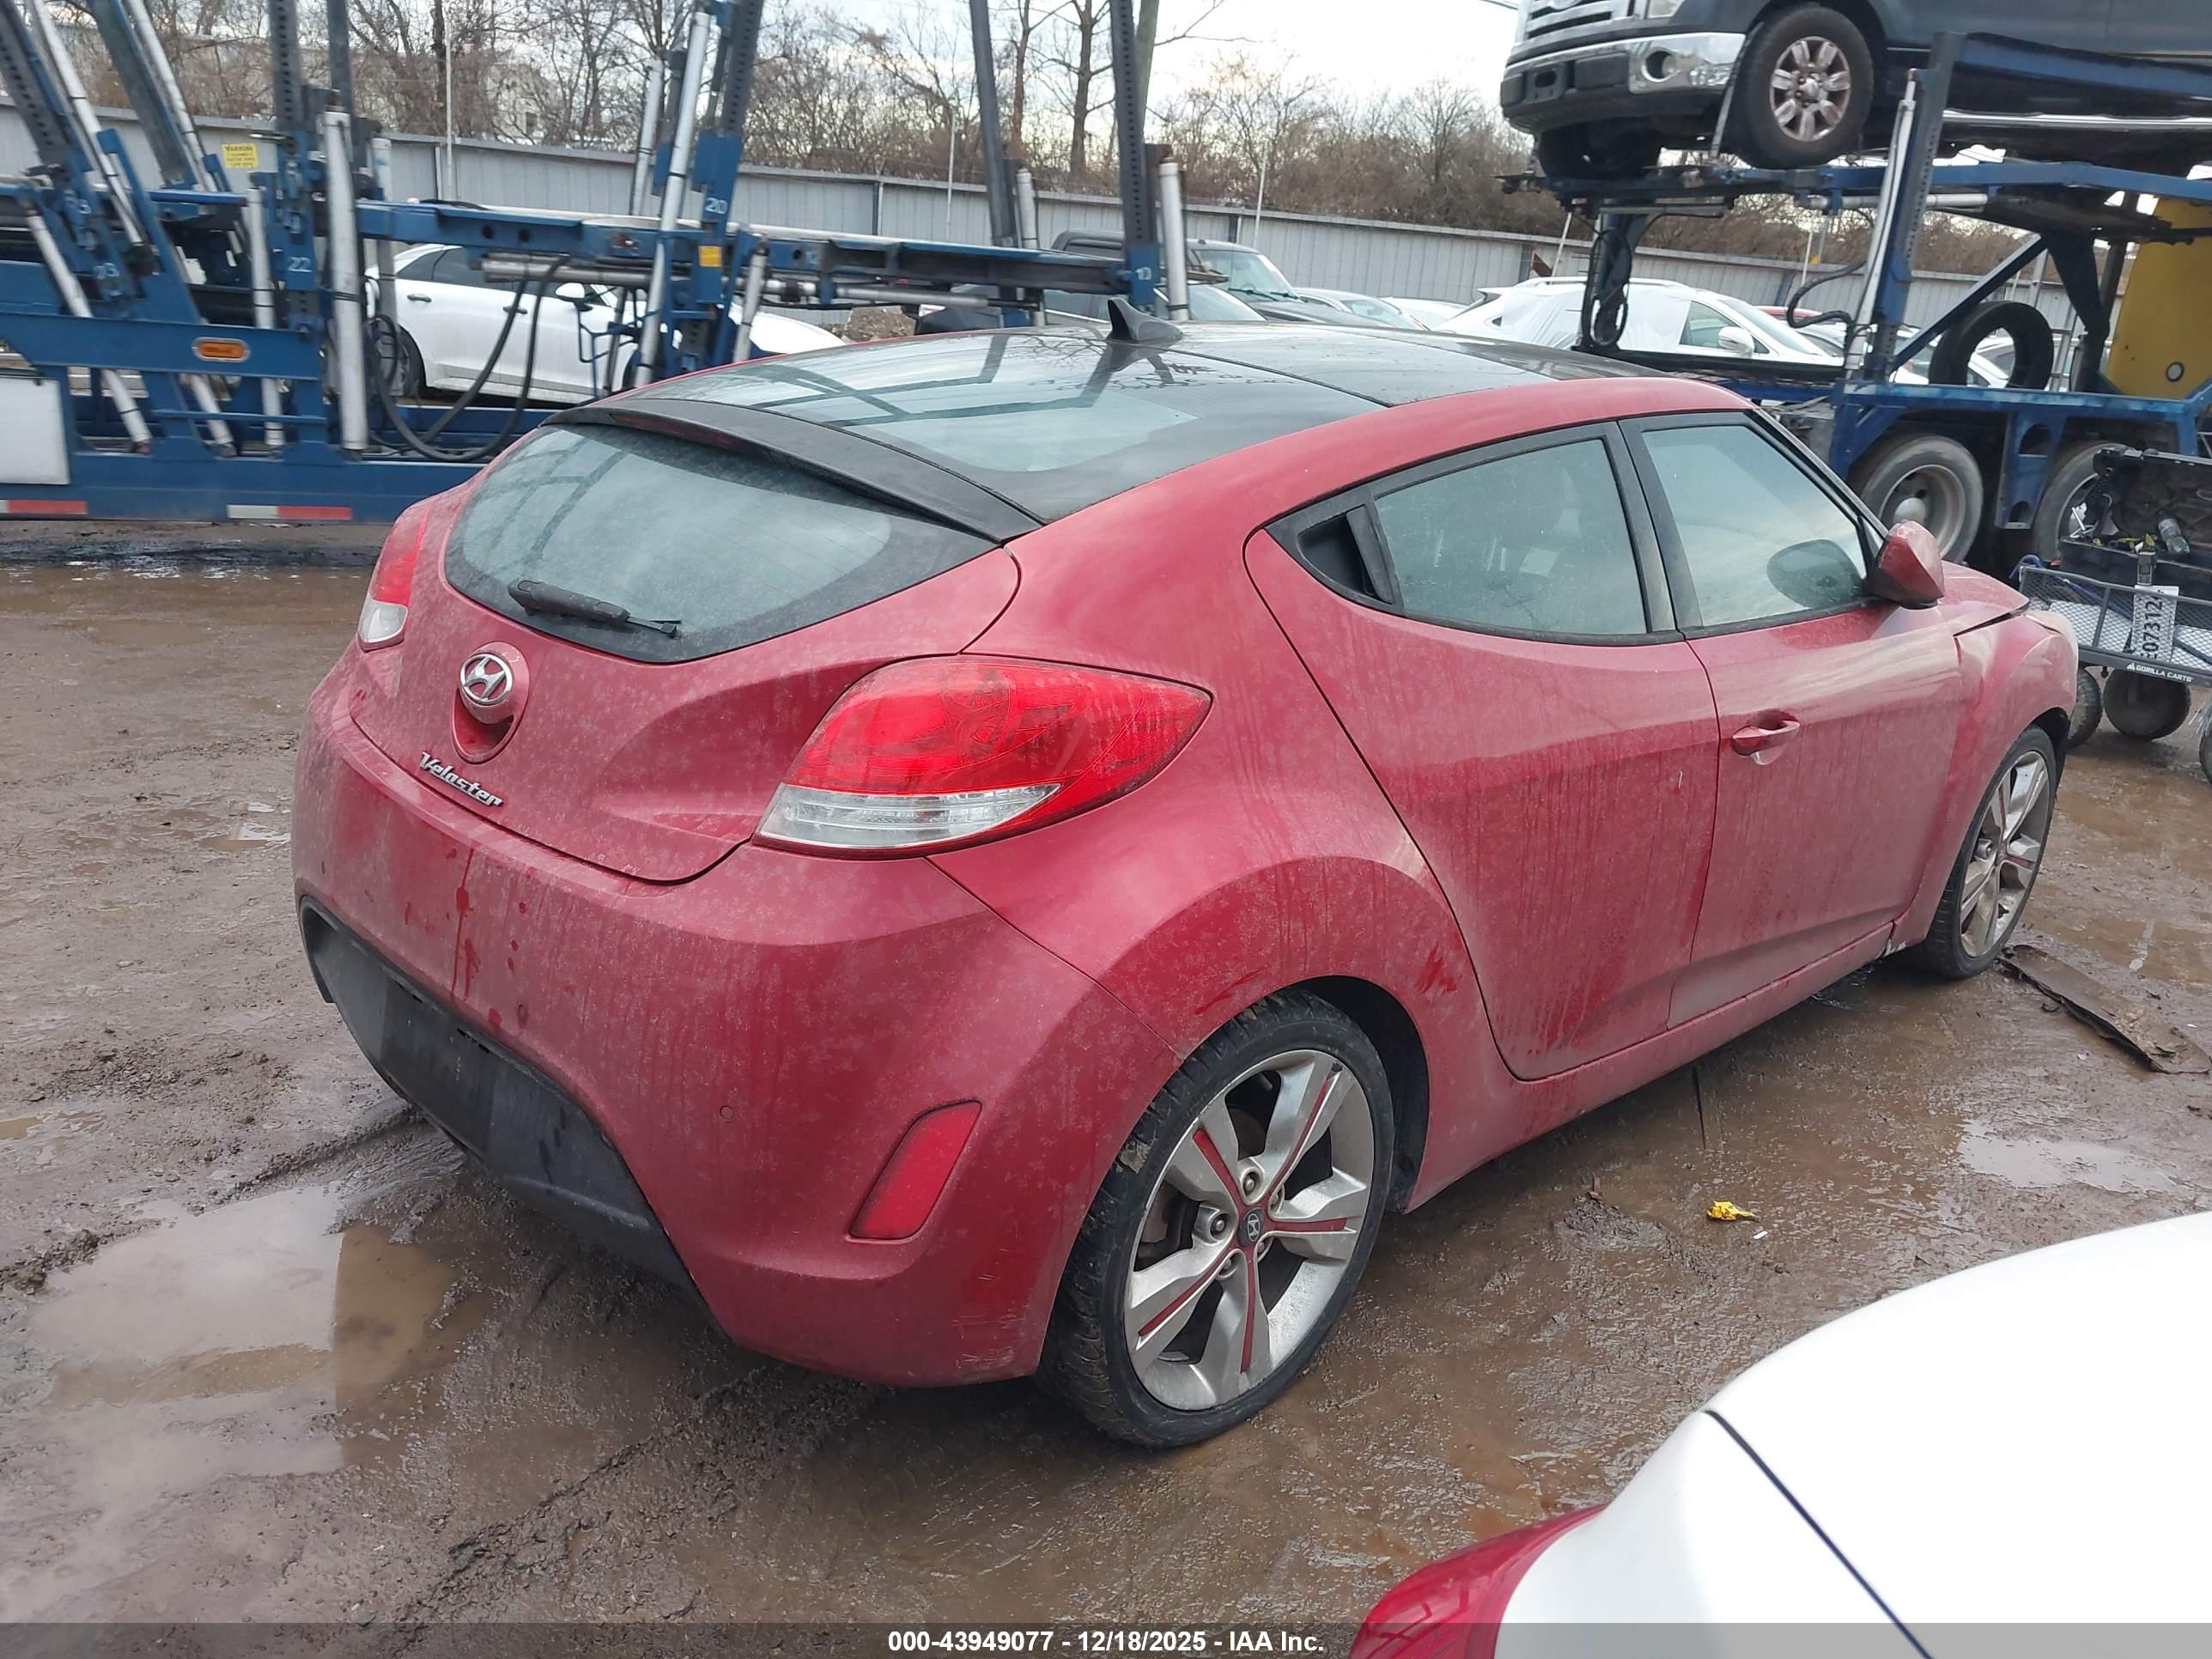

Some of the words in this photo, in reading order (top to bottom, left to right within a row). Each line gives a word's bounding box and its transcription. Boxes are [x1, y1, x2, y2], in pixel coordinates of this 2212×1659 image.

[705, 197, 728, 215] 20
[287, 256, 313, 273] 22
[2136, 665, 2166, 677] GORILLA
[419, 750, 503, 806] Veloster
